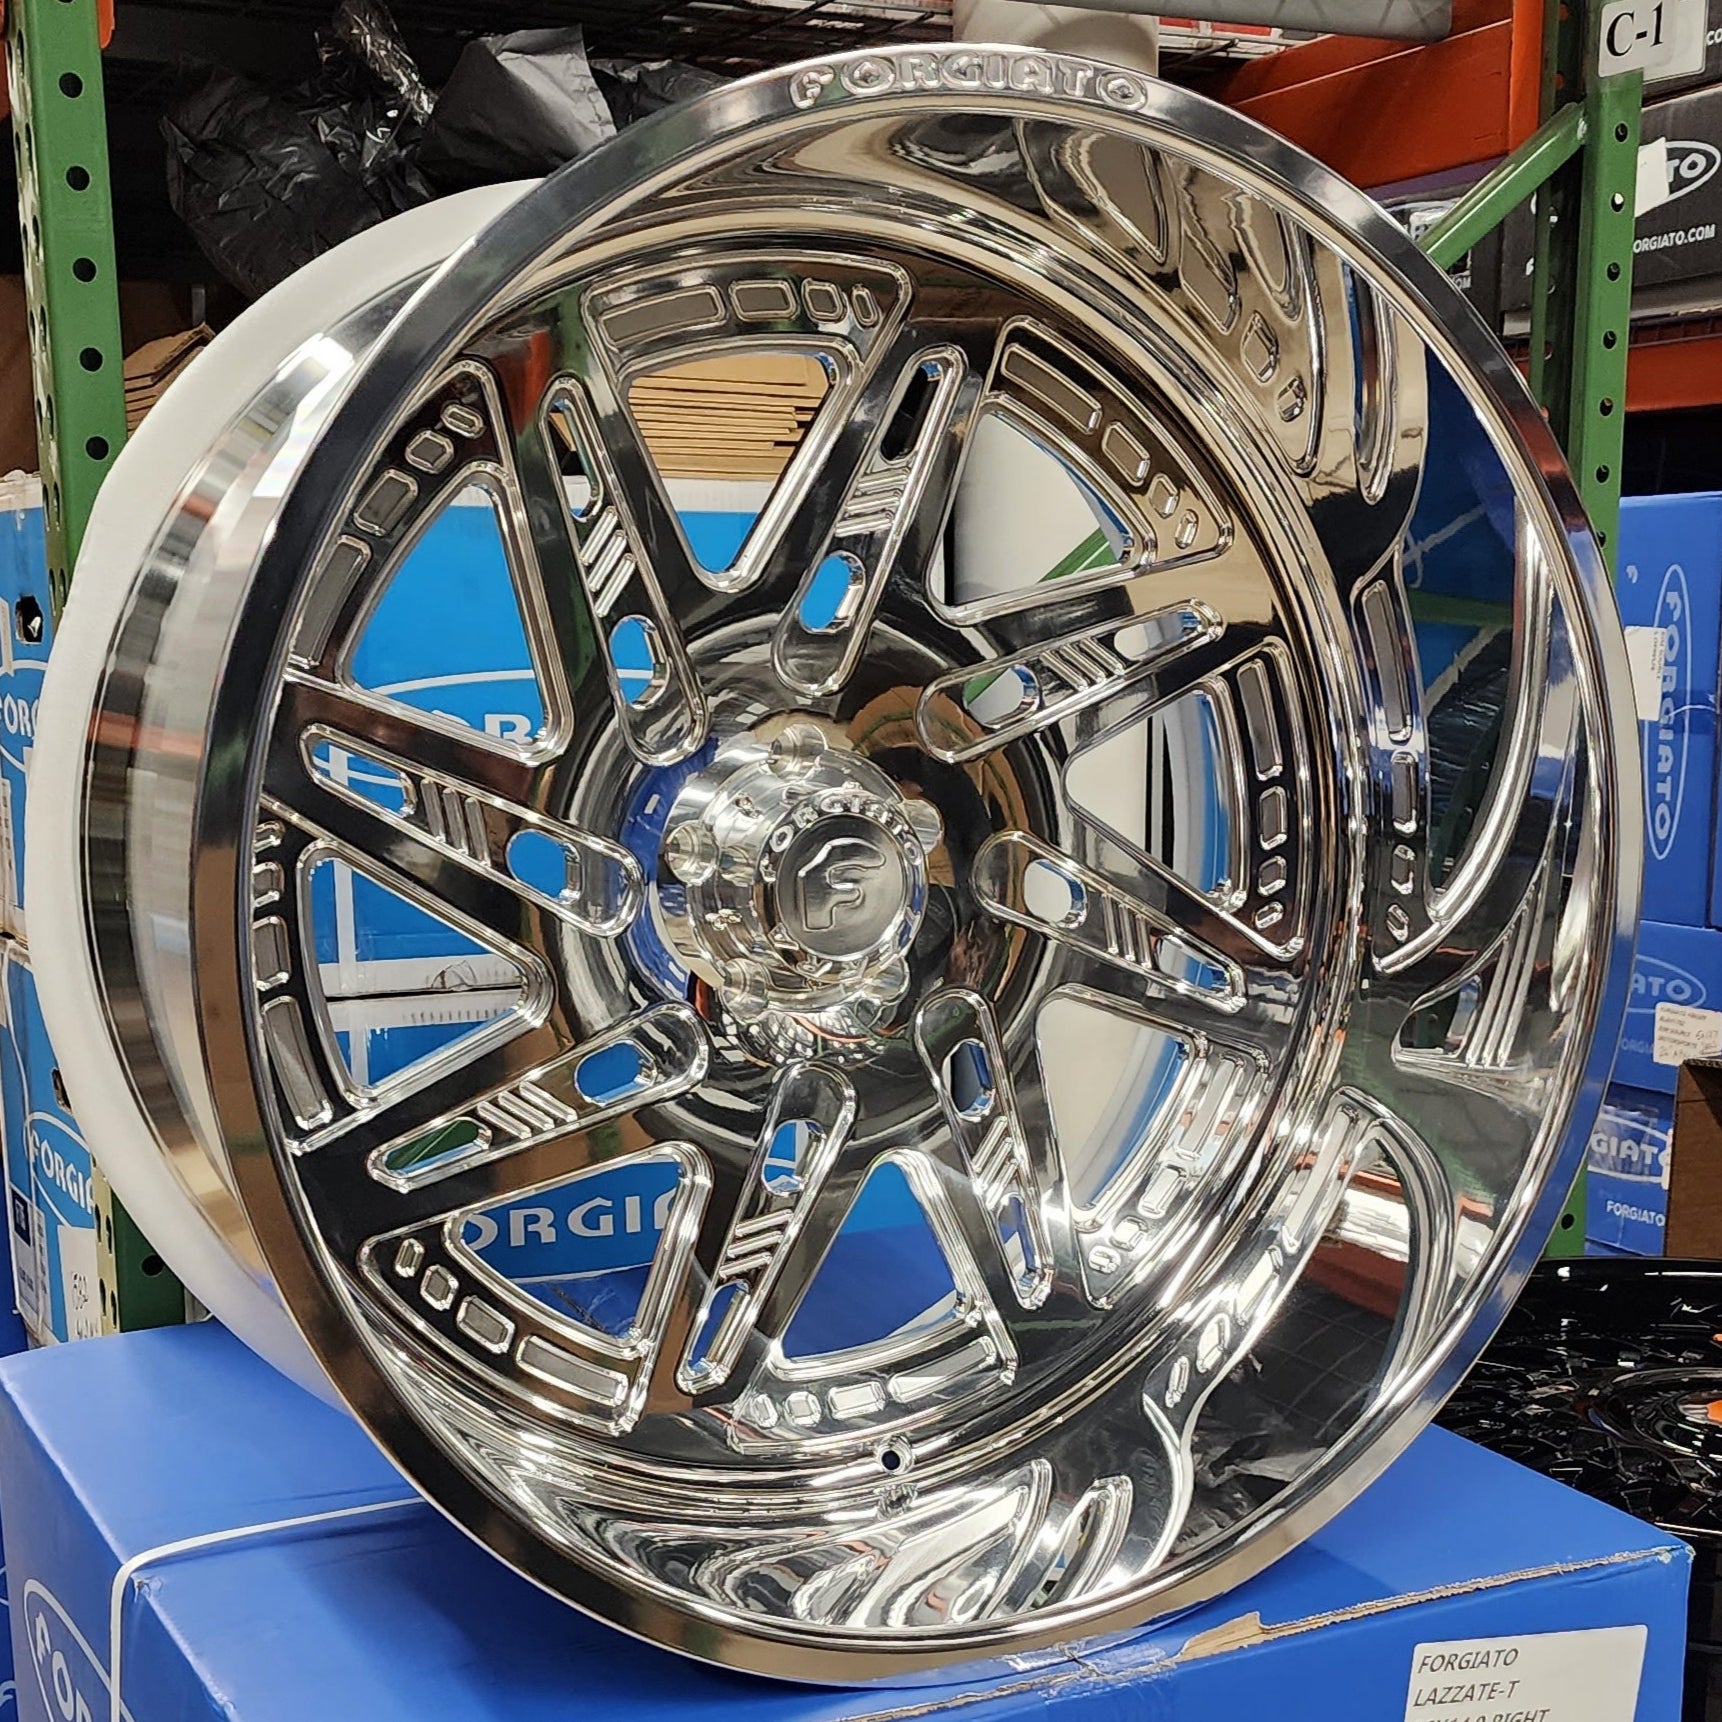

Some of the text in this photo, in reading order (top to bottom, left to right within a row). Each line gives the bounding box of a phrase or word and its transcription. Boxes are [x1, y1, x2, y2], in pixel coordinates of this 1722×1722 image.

[1606, 2, 1664, 57] C-1
[789, 51, 1148, 111] FORGIATO
[759, 793, 921, 883] FORGIATO
[1606, 1200, 1666, 1227] FORGIATO
[1417, 1648, 1519, 1674] FORGIATO
[1413, 1680, 1520, 1707] LAZZATE-T
